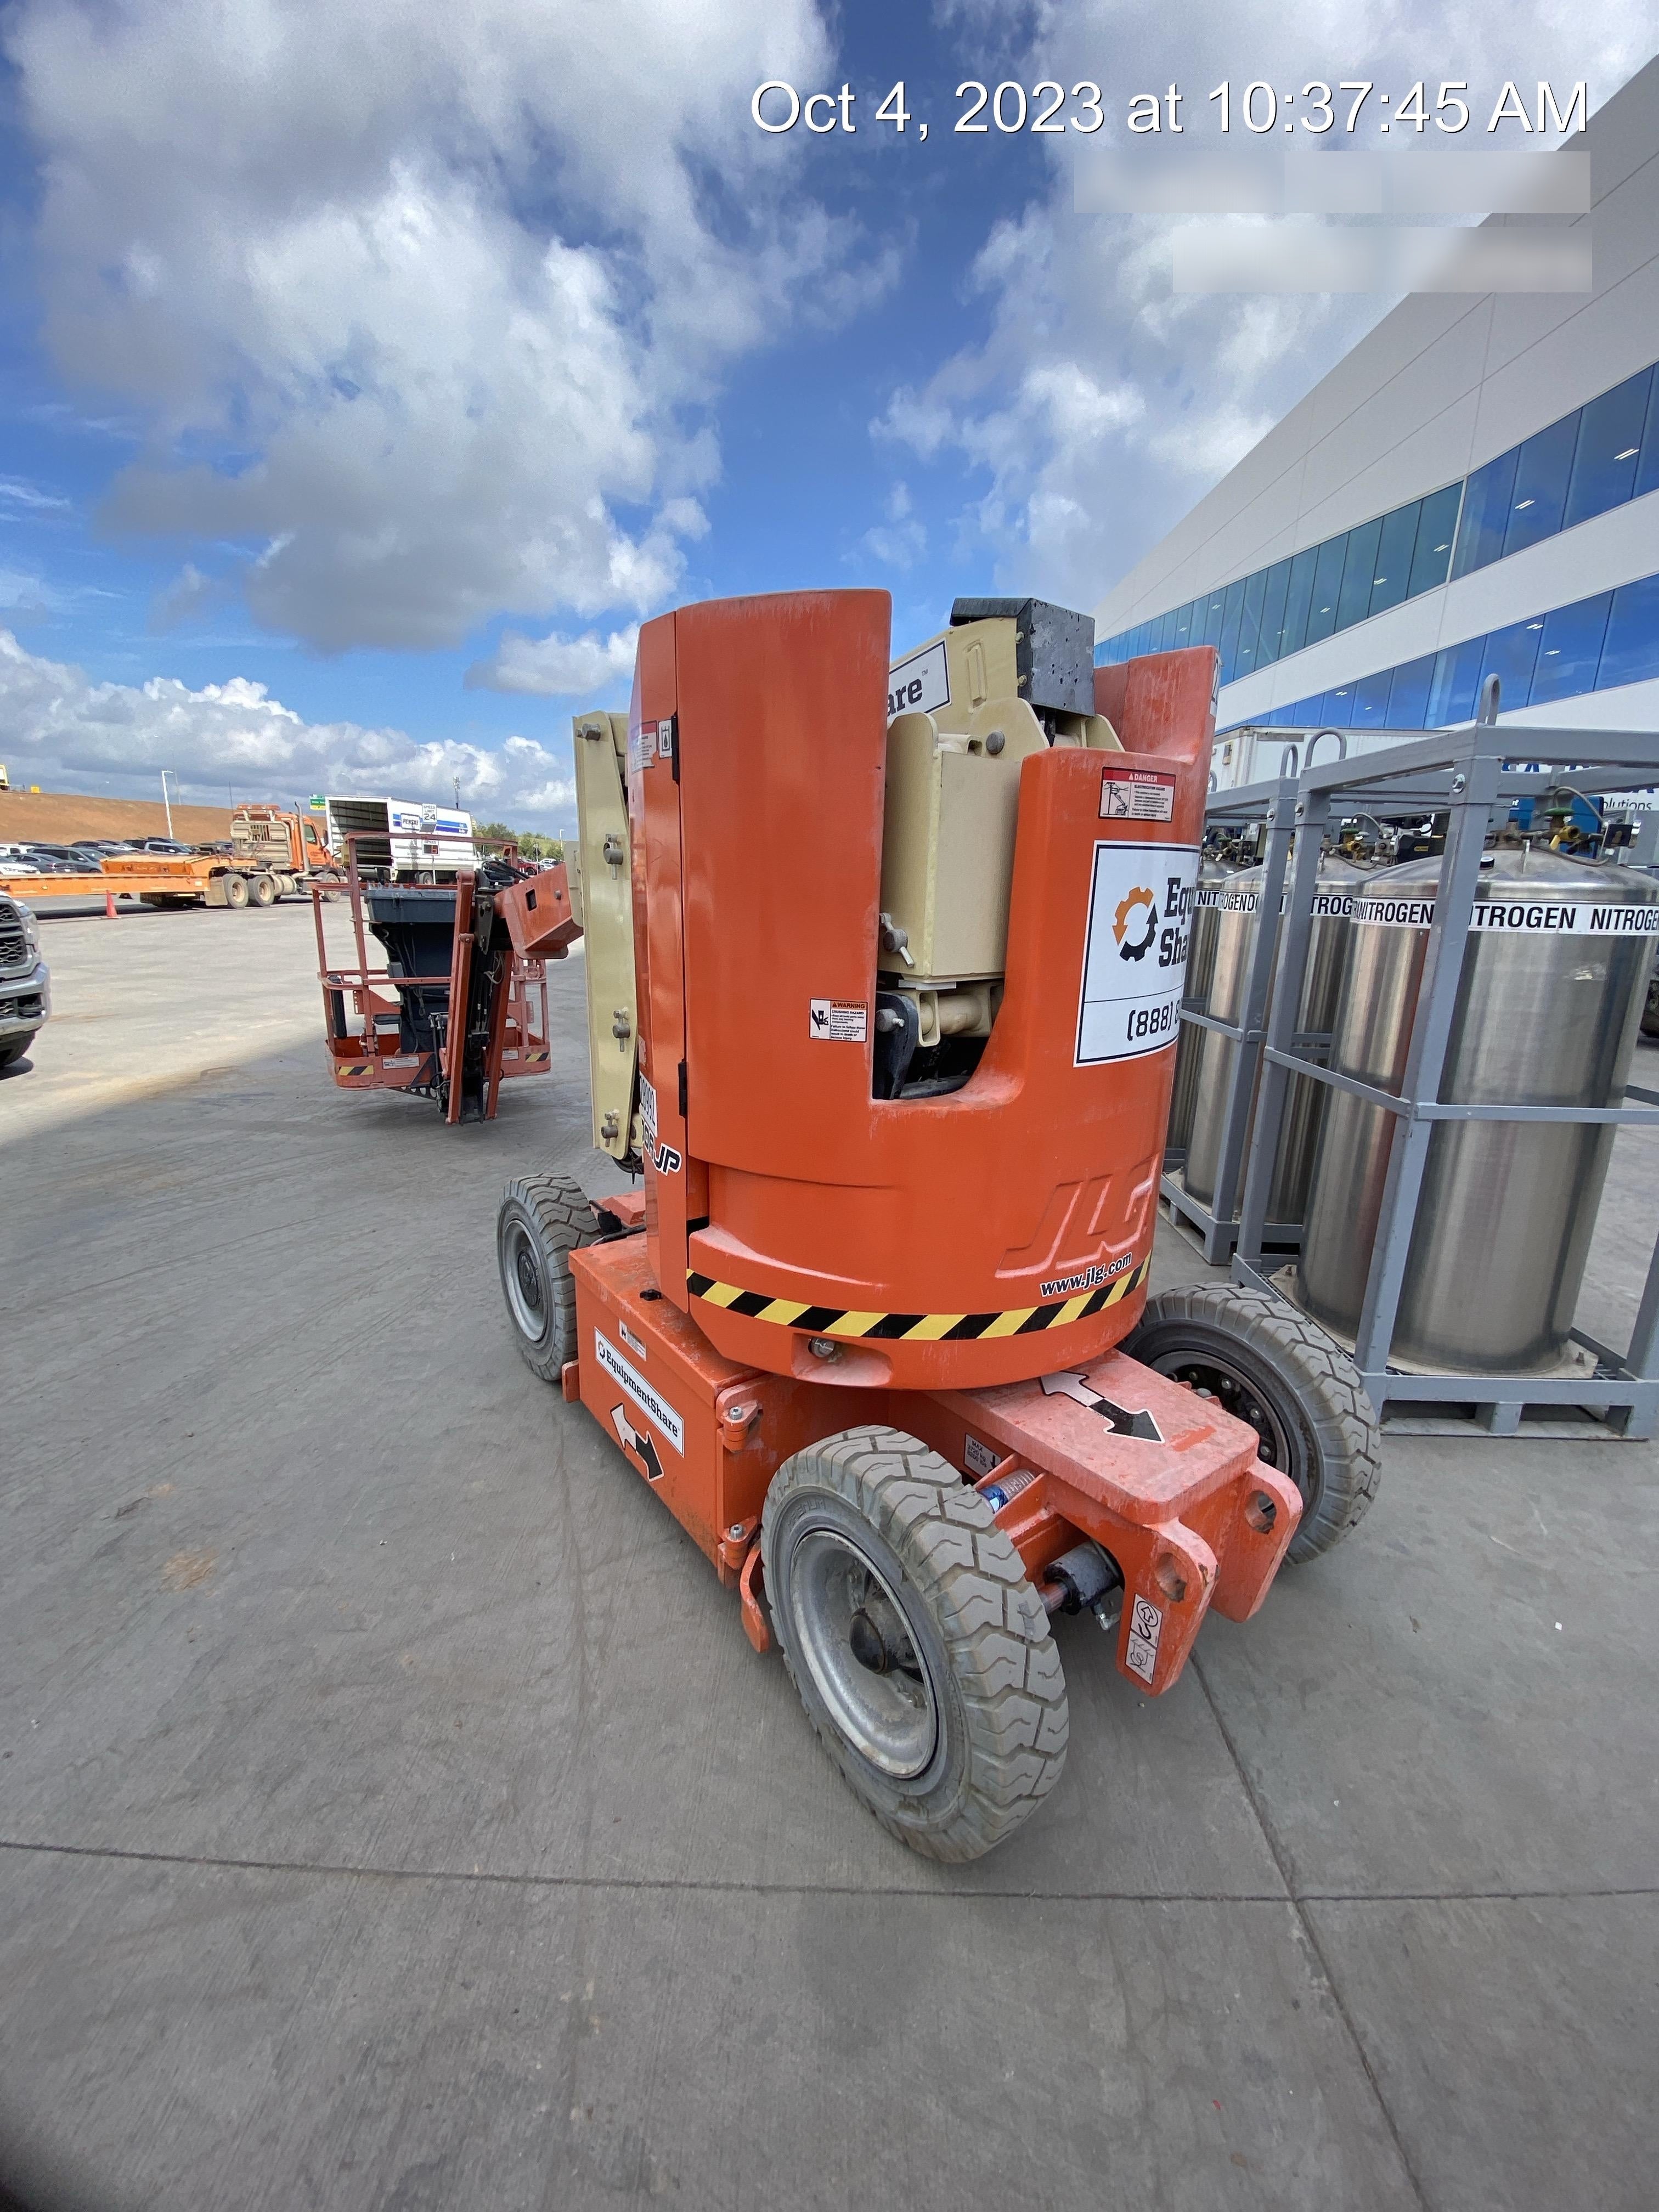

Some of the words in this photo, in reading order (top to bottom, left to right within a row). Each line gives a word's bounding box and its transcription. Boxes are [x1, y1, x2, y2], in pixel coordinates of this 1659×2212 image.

[1134, 774, 1158, 783] DANGER
[1127, 1001, 1173, 1041] (888)
[1041, 1252, 1132, 1296] www.jlg.com
[606, 1349, 679, 1437] EquipmentShare
